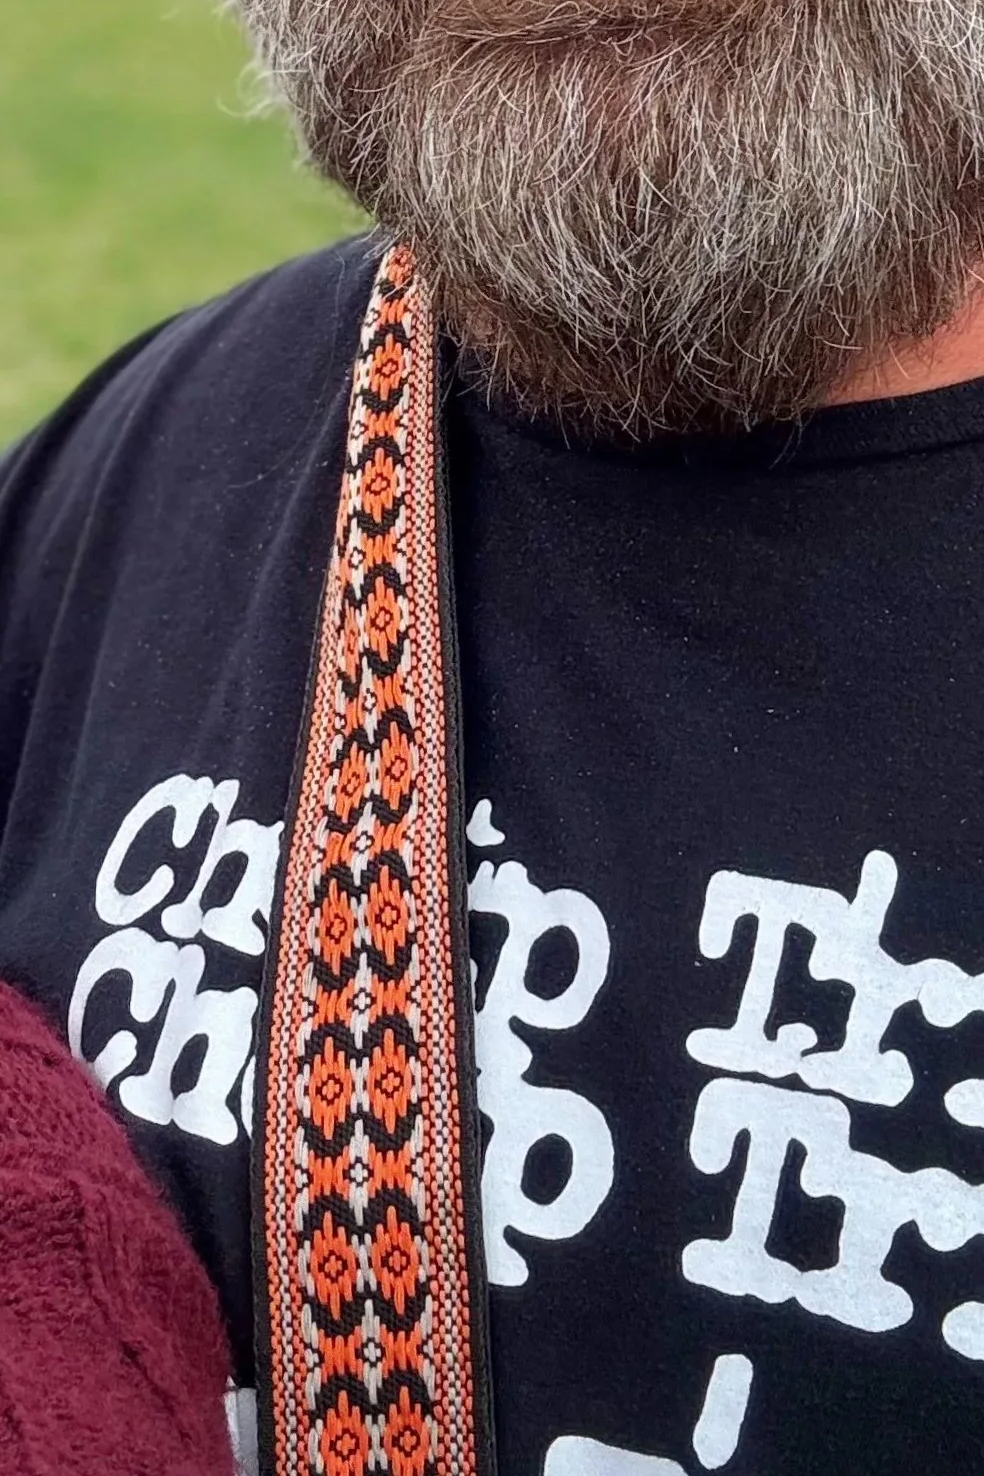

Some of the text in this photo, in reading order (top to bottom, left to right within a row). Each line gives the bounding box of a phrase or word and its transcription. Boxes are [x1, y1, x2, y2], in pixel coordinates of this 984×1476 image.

[67, 927, 984, 1360] Chp Tr
[96, 774, 984, 1127] Chp Tr
